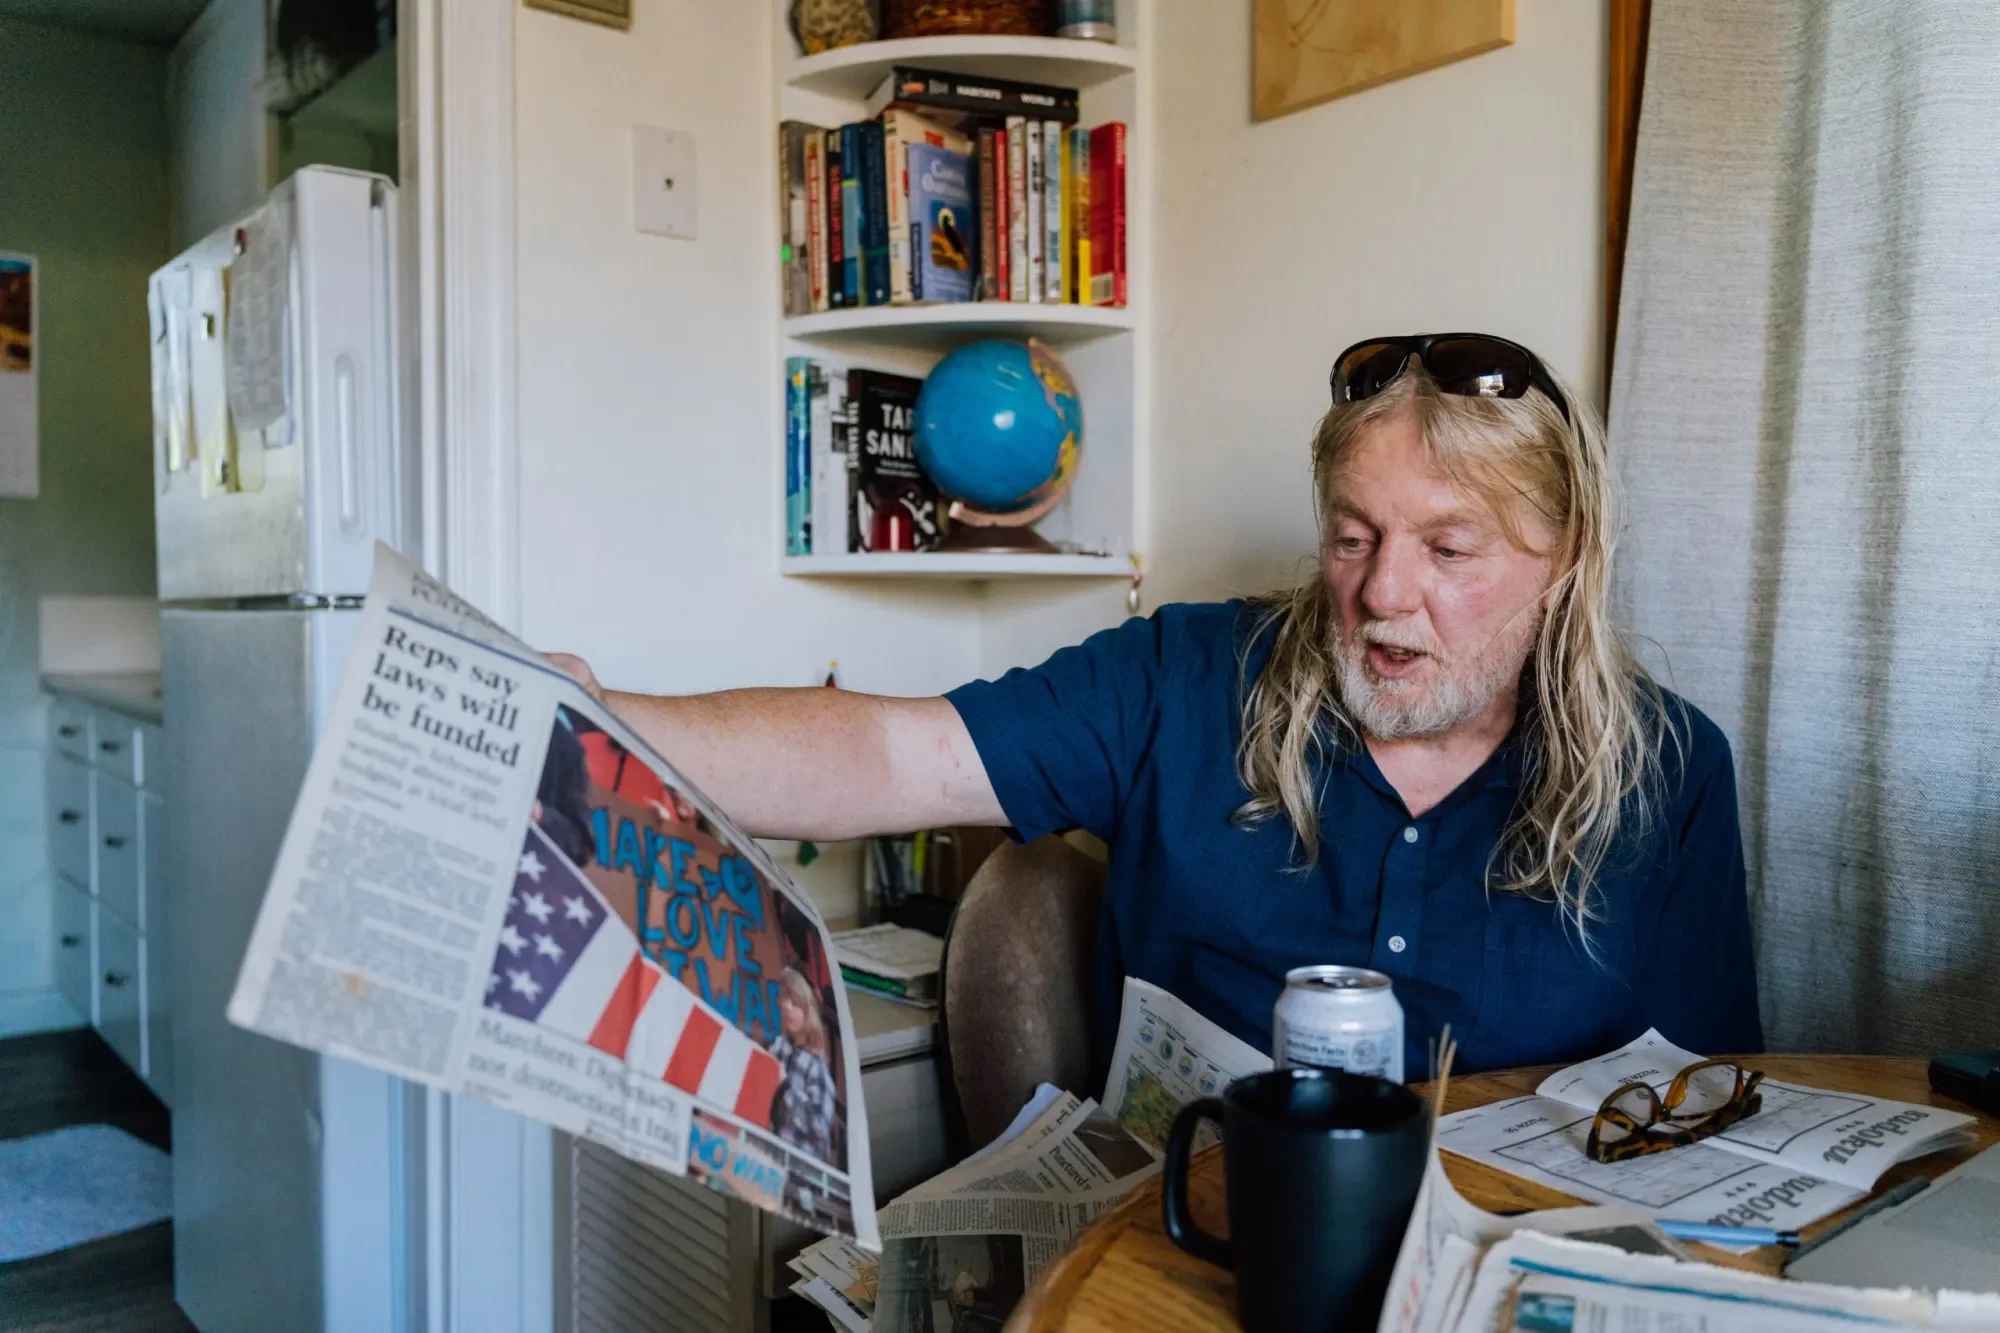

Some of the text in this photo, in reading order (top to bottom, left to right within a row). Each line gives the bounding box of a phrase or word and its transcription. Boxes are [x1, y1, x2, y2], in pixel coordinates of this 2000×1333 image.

[1020, 93, 1056, 107] WORLD
[866, 429, 915, 458] SAN
[372, 652, 521, 733] laws will
[384, 624, 521, 698] Reps say
[362, 683, 522, 768] be funded
[637, 895, 763, 974] LOVE
[688, 1122, 729, 1171] NO
[732, 1149, 786, 1197] WAR
[1822, 1109, 1931, 1166] sudoku
